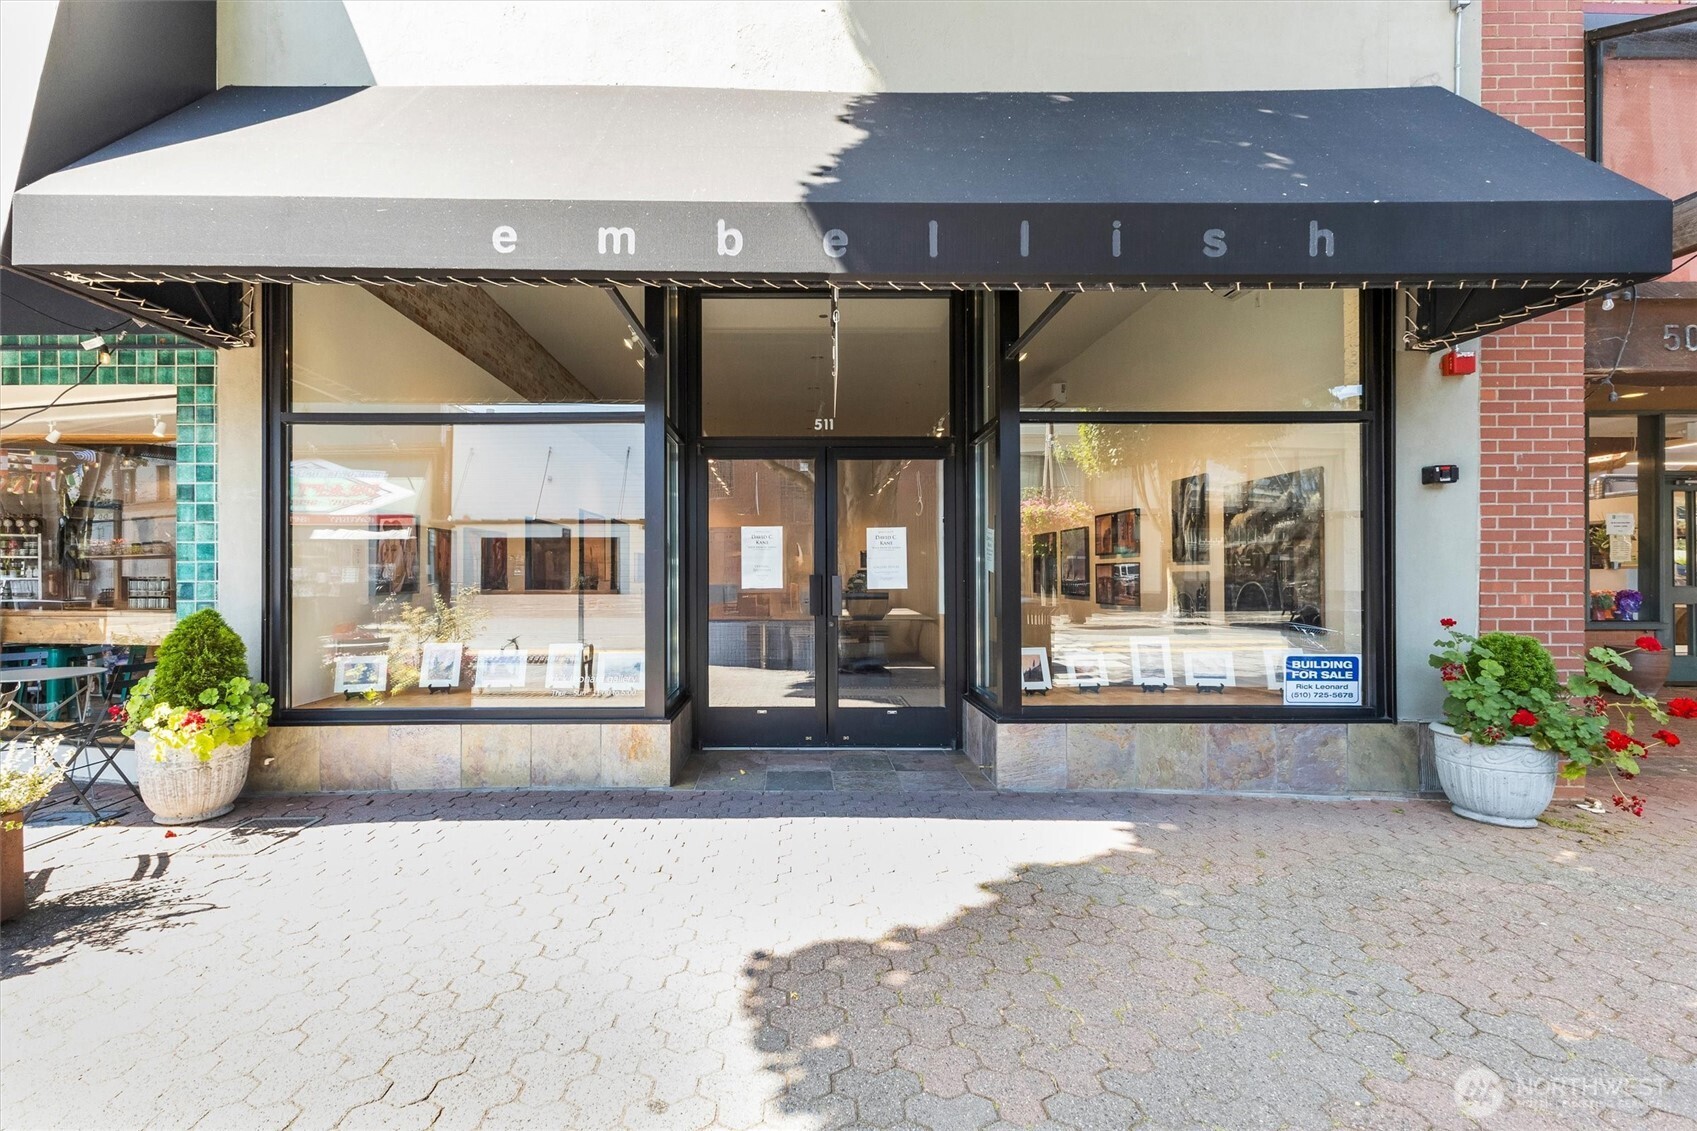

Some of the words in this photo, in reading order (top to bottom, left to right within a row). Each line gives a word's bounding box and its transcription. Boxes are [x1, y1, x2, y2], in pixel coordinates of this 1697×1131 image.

[491, 218, 1335, 258] embellish
[813, 418, 834, 430] 511
[1291, 660, 1353, 669] BUILDING
[608, 674, 637, 684] gallery
[1291, 671, 1318, 679] FOR
[1320, 671, 1354, 679] SALE
